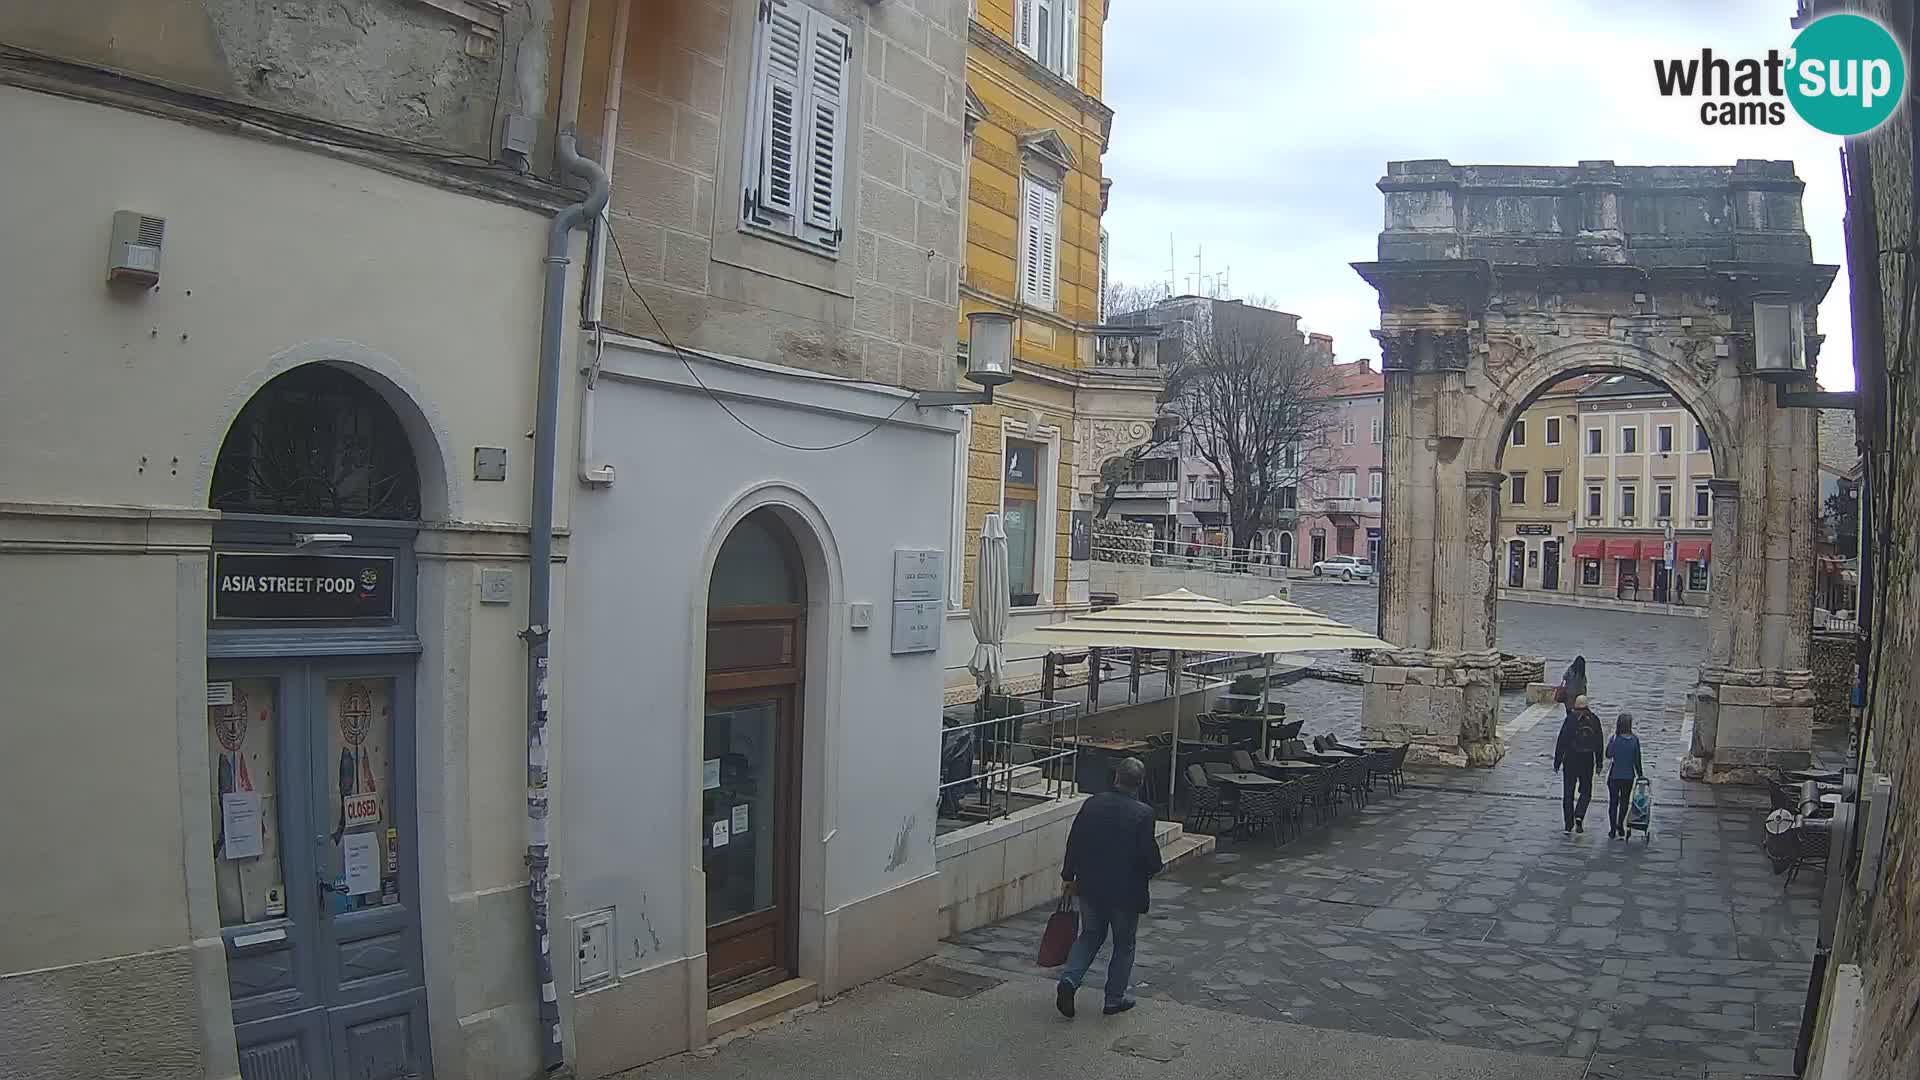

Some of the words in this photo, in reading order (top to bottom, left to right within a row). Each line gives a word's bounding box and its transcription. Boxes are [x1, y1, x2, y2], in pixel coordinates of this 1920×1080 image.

[221, 575, 256, 592] ASIA
[258, 576, 314, 593] STREET
[316, 577, 355, 594] FOOD
[347, 799, 376, 818] CLOSED
